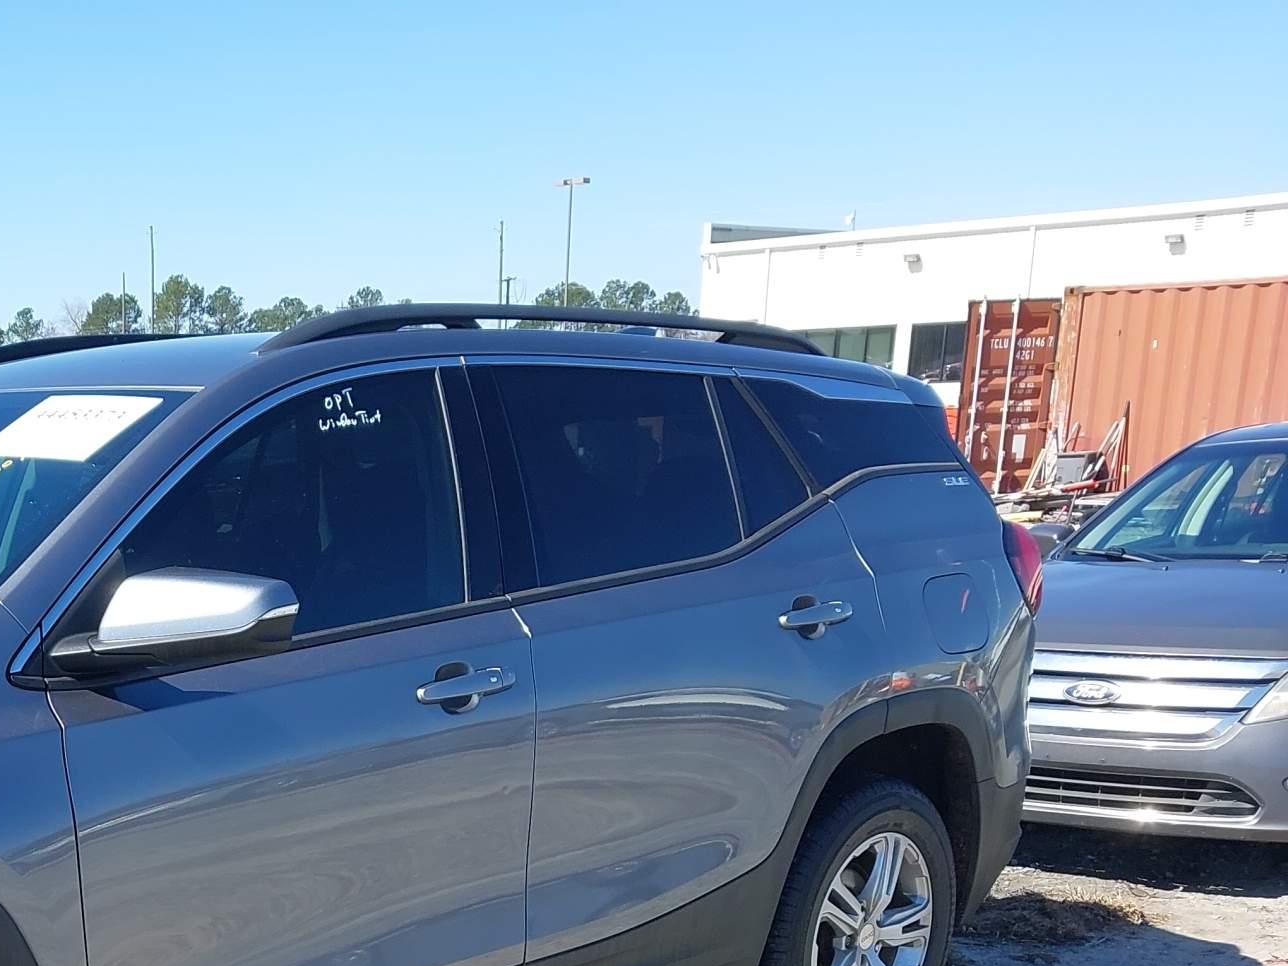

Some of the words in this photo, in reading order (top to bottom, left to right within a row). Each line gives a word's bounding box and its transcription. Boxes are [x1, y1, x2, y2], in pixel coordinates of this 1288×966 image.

[990, 338, 1009, 349] TCLU
[1017, 337, 1045, 348] 400146
[1015, 350, 1035, 361] 42G1
[324, 387, 354, 411] OPT
